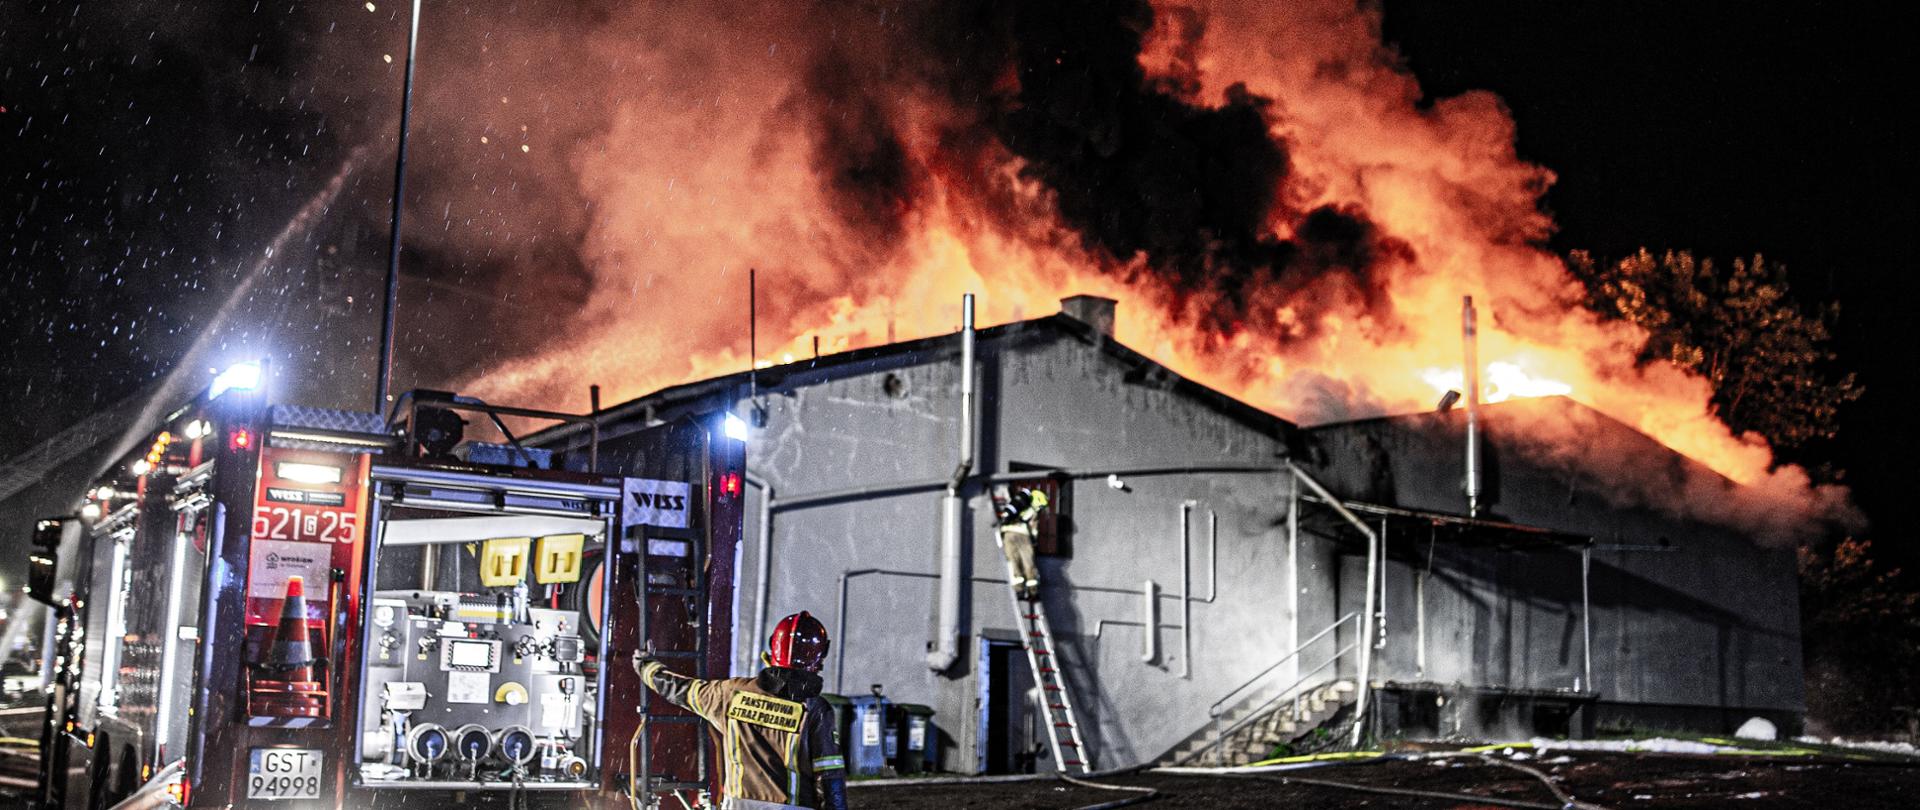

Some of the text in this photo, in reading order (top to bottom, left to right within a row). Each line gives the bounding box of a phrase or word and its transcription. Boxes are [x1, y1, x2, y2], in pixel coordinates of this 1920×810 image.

[631, 492, 685, 511] WISS
[320, 512, 357, 544] 25
[266, 752, 309, 773] GST
[252, 776, 318, 796] 94998
